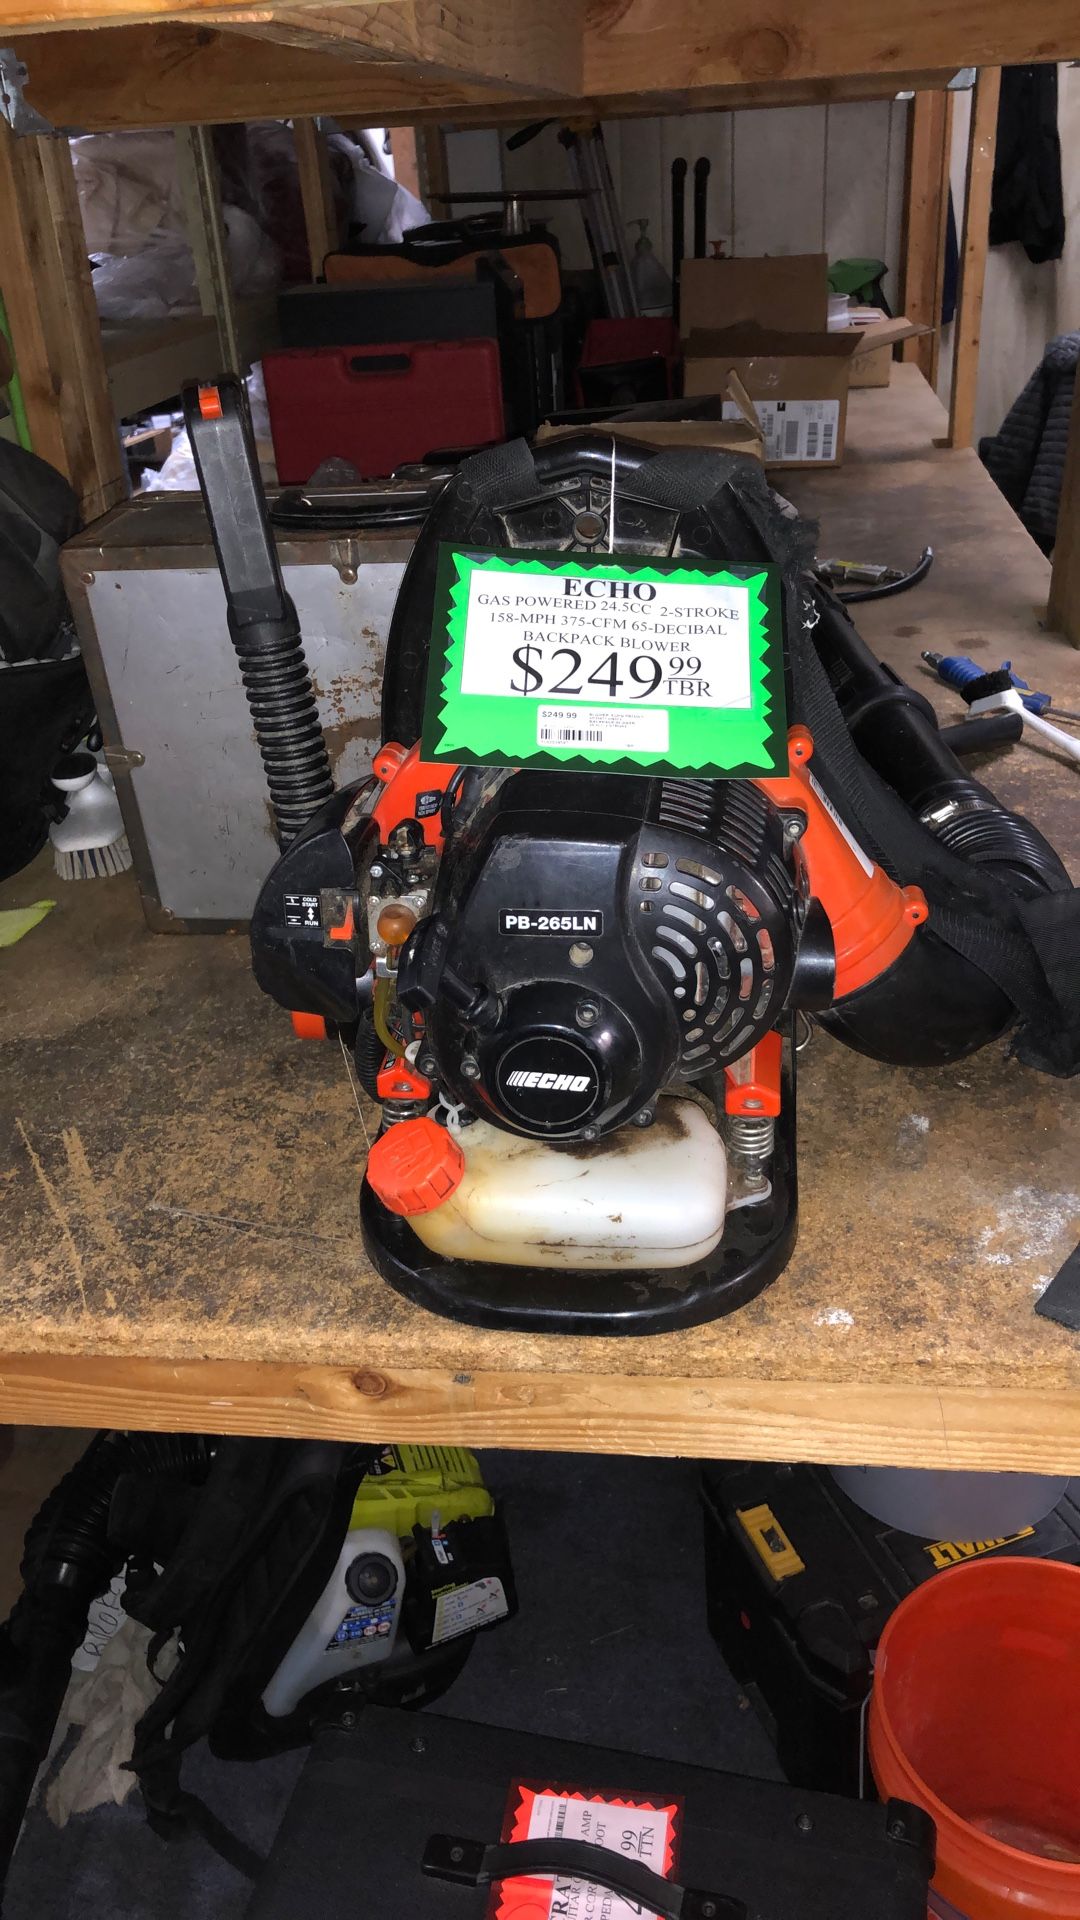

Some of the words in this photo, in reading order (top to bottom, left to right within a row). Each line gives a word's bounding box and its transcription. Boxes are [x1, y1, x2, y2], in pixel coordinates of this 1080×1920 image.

[562, 578, 657, 601] ECHO
[477, 593, 511, 606] GAS
[515, 595, 597, 611] POWERED
[600, 600, 652, 615] 24.5CC
[660, 606, 740, 620] 2-STROKE
[490, 612, 556, 625] 158-MPH
[561, 615, 627, 630] 375-CFM
[631, 620, 728, 636] 65-DECIBAL
[523, 630, 615, 647] BACKPACK
[620, 636, 692, 652] BLOWER
[510, 644, 663, 699] $249
[669, 656, 702, 676] 99
[663, 678, 713, 698] TBR
[505, 915, 597, 931] PB-265LN
[506, 1070, 591, 1092] ECHO
[581, 1810, 592, 1836] AMP
[621, 1829, 638, 1851] 99
[639, 1826, 655, 1857] TTN
